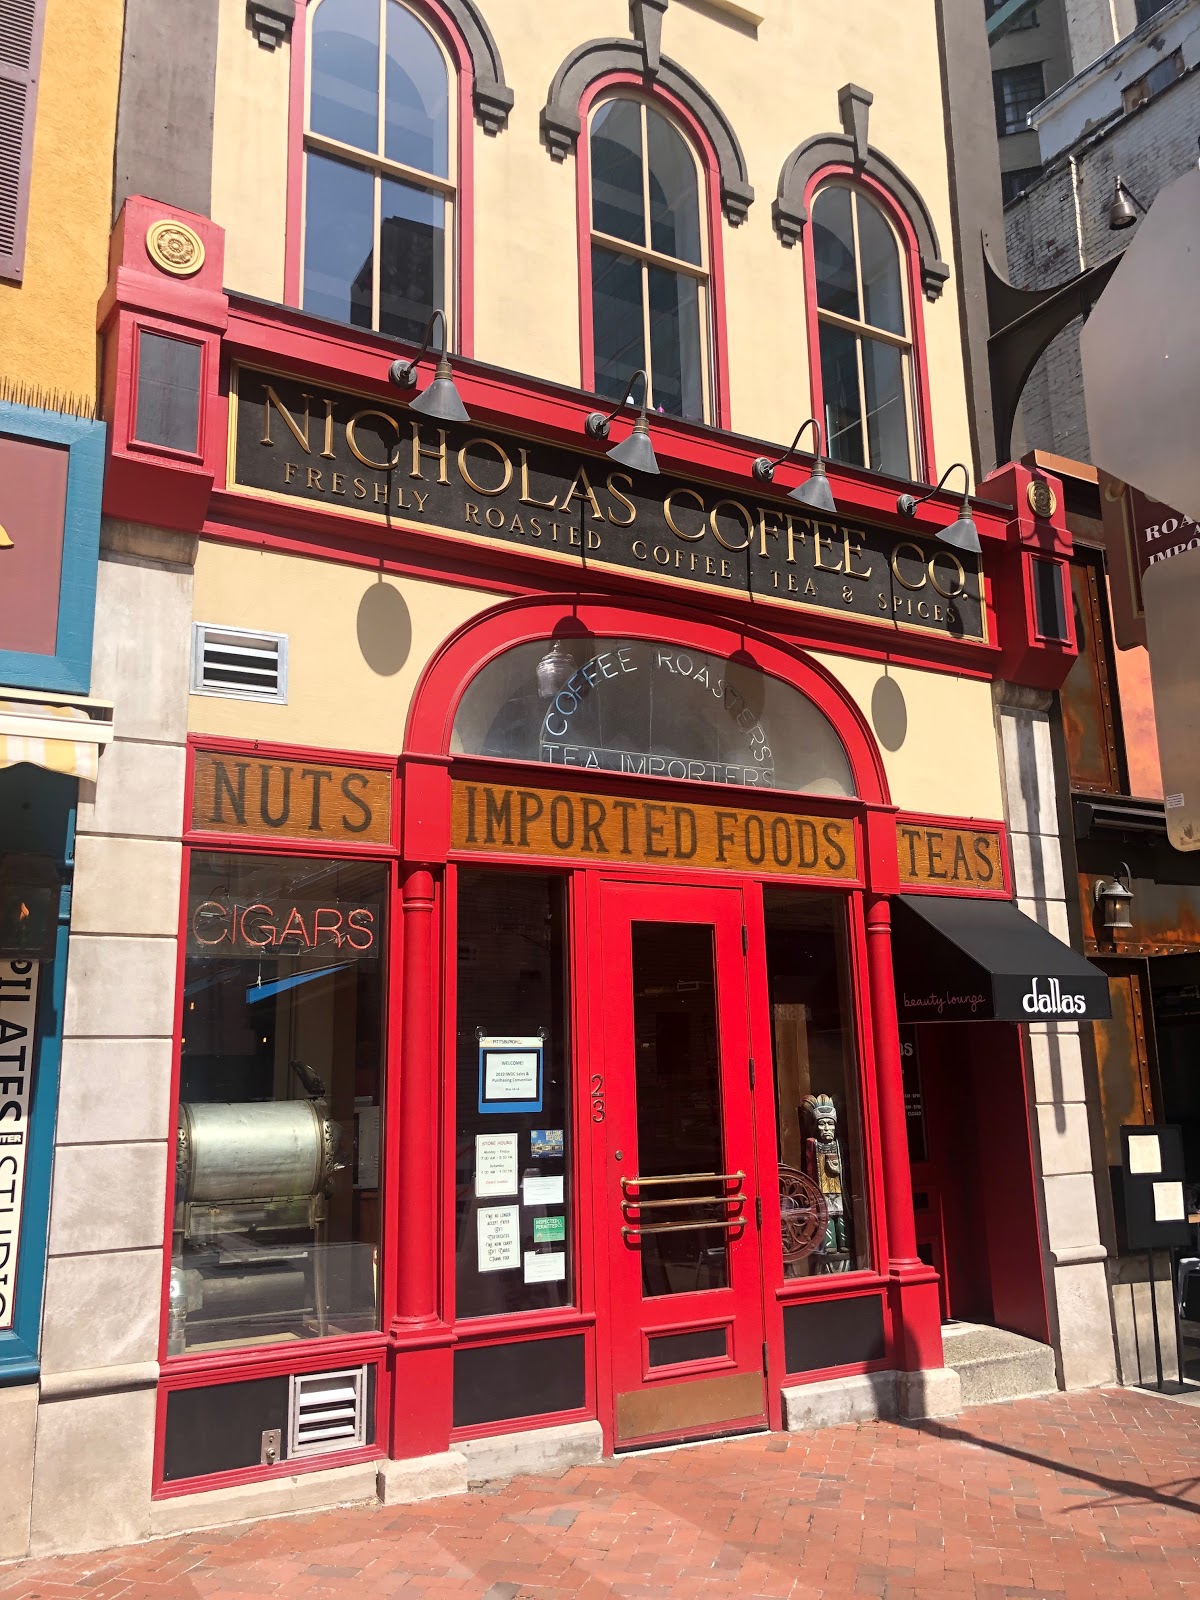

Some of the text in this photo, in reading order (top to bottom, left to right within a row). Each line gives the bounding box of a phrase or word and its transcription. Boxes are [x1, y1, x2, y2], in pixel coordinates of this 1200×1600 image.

[259, 384, 969, 601] NICHOLAS COFFEE CO.
[283, 462, 956, 624] FRESHLY ROASTED COFFEE TEA & SPICES
[545, 647, 773, 762] COFFEE ROASTERS
[208, 760, 373, 833] NUTS
[543, 743, 774, 788] TEA IMPORTERS
[465, 786, 847, 871] IMPORTED FOODS
[902, 829, 994, 882] TEAS
[192, 901, 374, 949] CIGARS
[903, 991, 986, 1014] beauty lounge
[1022, 977, 1087, 1014] dallas
